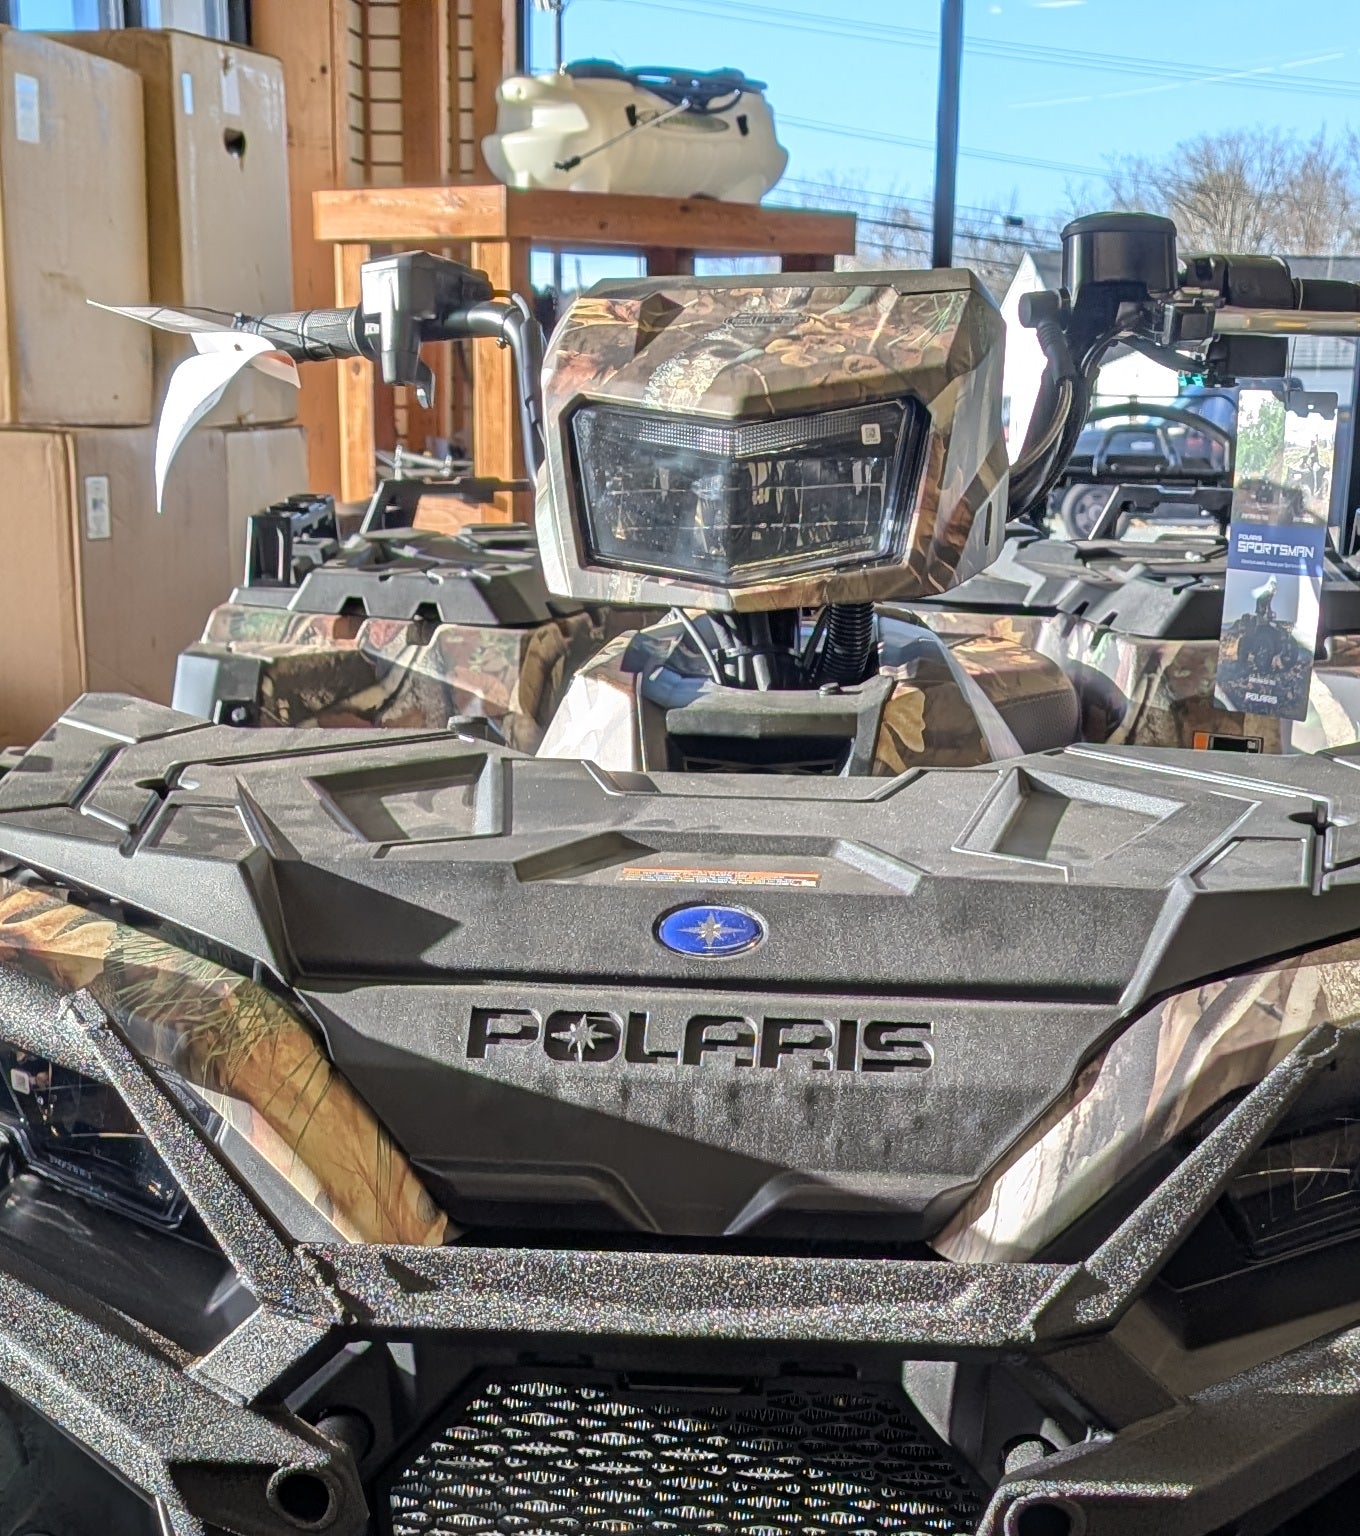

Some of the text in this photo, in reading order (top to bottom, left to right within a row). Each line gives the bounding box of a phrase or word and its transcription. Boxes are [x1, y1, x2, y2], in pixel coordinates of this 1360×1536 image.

[1237, 541, 1315, 559] SPORTSMAN
[1244, 692, 1278, 705] POLARIS
[465, 1005, 934, 1074] POLARIS
